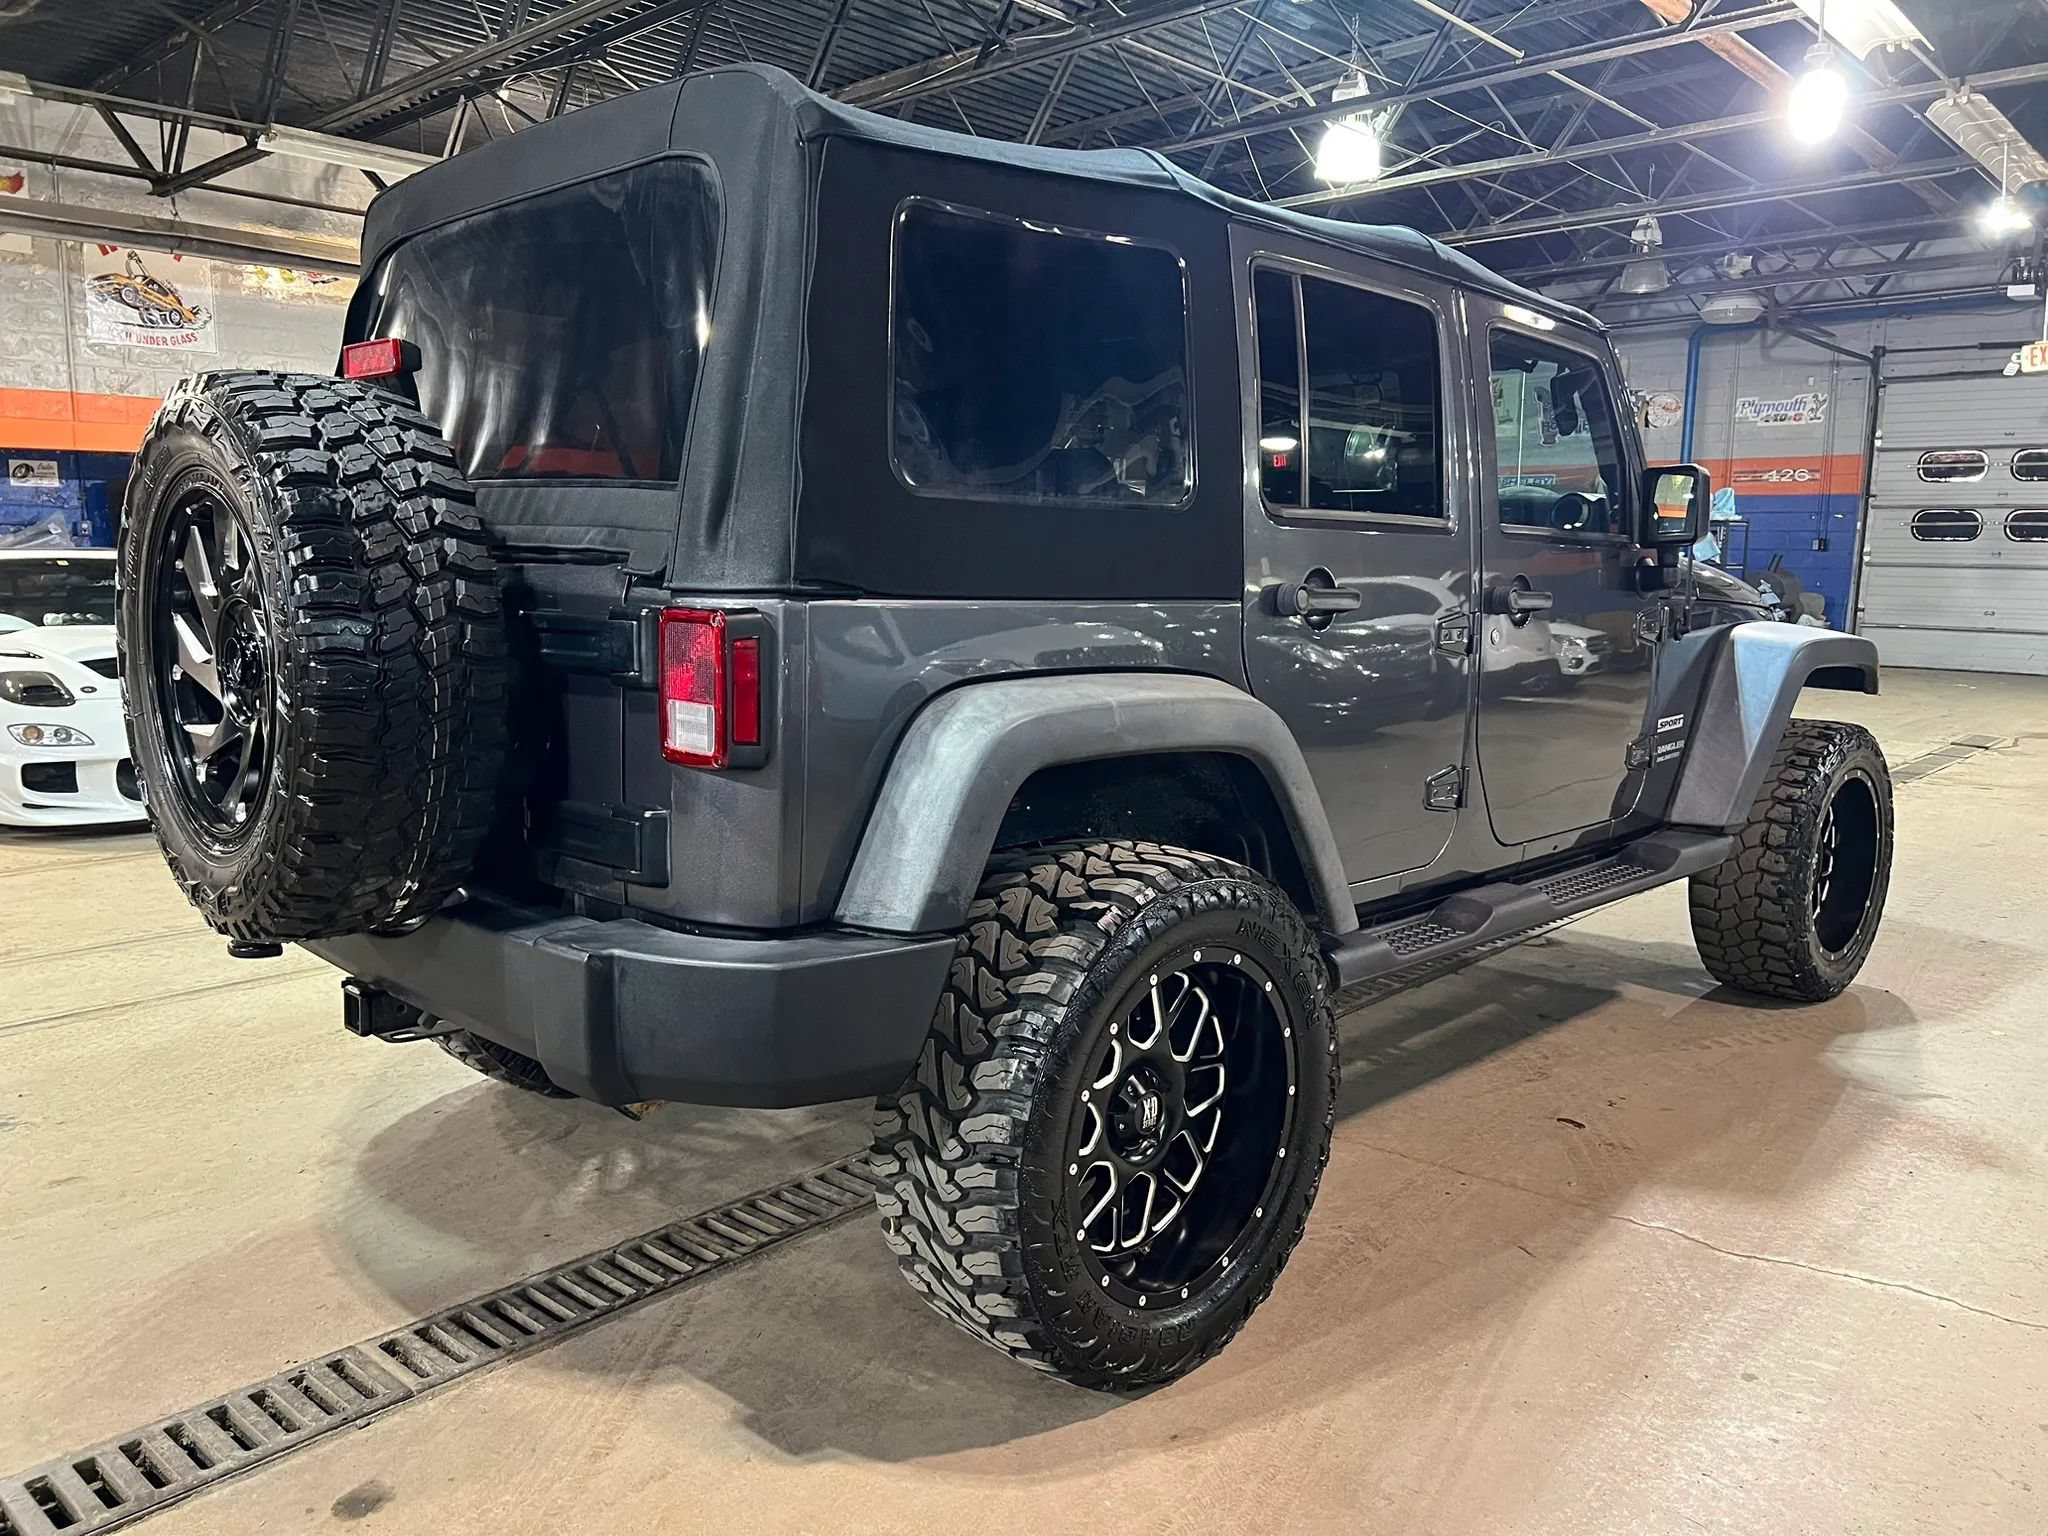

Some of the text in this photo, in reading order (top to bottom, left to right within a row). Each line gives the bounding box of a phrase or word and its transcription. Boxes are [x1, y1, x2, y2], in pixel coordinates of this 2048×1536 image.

[136, 333, 168, 346] UNDER
[171, 332, 198, 346] GLASS
[1739, 396, 1807, 417] Plymouth
[1767, 468, 1809, 482] 426
[1659, 718, 1682, 729] SPORT
[1656, 739, 1686, 754] RANGLER
[1234, 917, 1321, 1030] NEXEN
